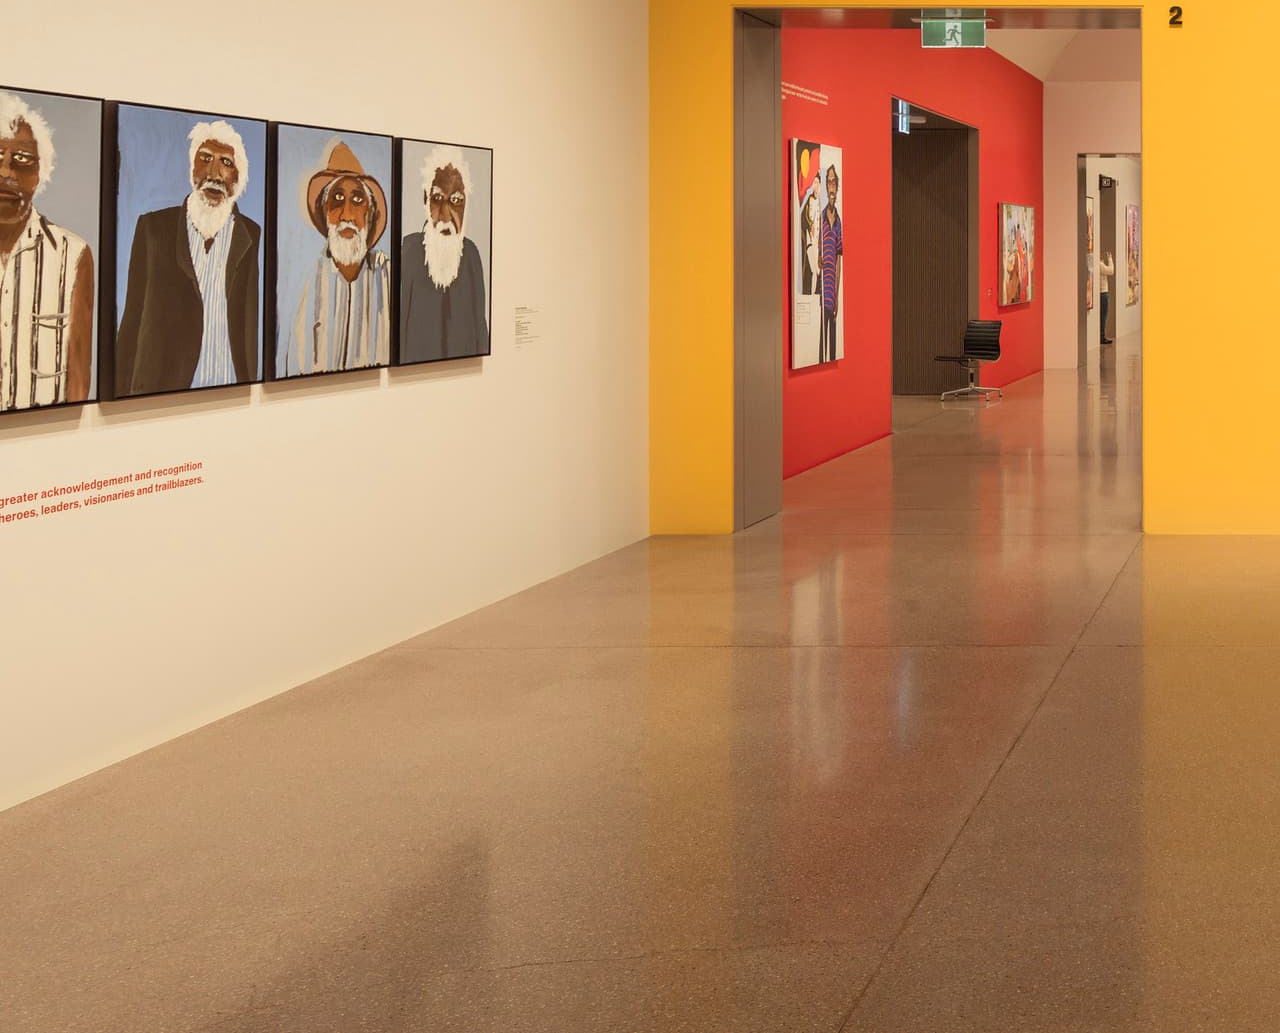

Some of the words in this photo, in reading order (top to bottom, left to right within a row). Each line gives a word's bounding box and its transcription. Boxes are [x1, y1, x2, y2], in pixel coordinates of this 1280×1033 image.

[1169, 6, 1183, 24] 2
[0, 492, 38, 509] greater
[41, 474, 133, 499] acknowledgement
[135, 469, 151, 483] and
[153, 461, 203, 478] recognition
[41, 500, 82, 515] leaders,
[84, 489, 135, 507] visionaries
[137, 484, 153, 496] and
[155, 476, 204, 492] trailblazers.
